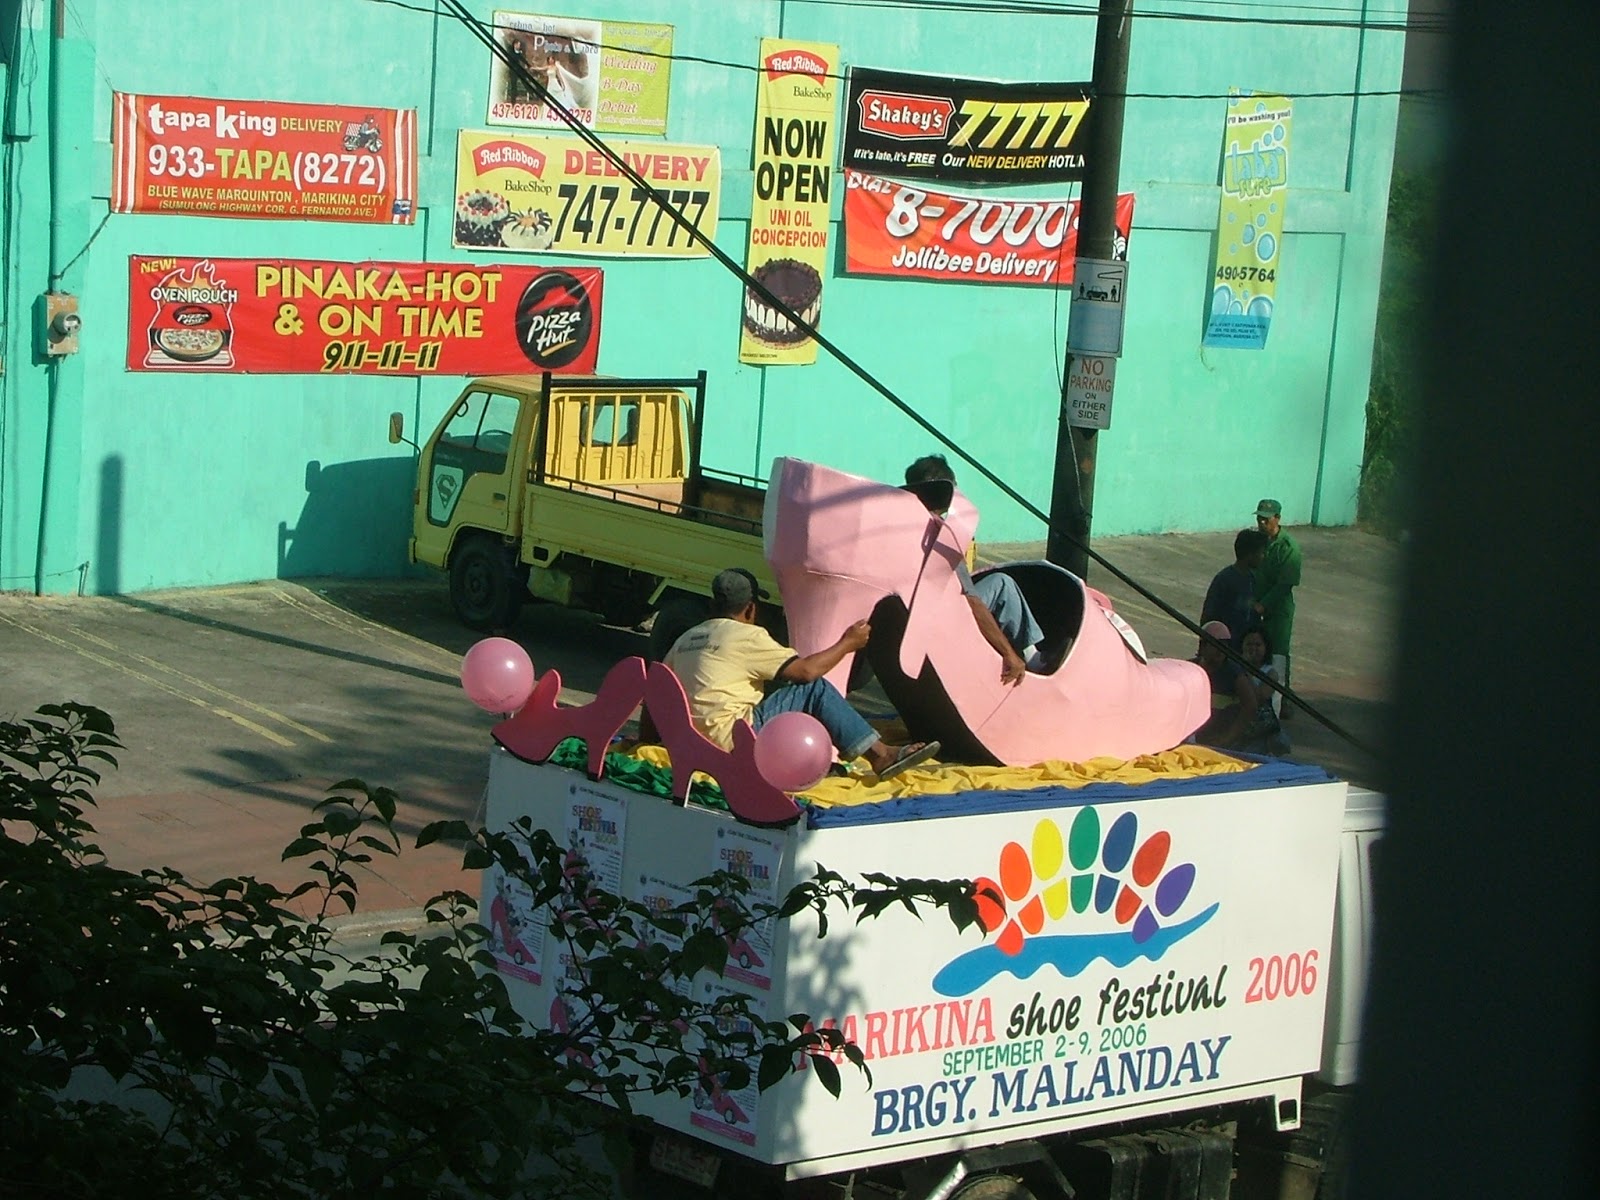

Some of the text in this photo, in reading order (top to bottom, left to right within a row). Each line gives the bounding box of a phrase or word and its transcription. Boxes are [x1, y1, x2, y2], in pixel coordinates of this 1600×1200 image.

[604, 56, 657, 74] Wedding
[772, 54, 825, 75] Red Ribbon
[793, 85, 832, 100] BakeShop
[492, 103, 539, 120] 437-6120
[601, 100, 636, 114] Debut
[868, 99, 943, 131] Shakey's
[1249, 112, 1276, 122] washing
[149, 102, 343, 139] tapa king DELIVERY
[947, 99, 1090, 149] 77777
[763, 116, 827, 159] NOW
[480, 147, 540, 169] Red Ribbon
[564, 149, 711, 182] DELIVERY
[861, 148, 873, 160] it's
[875, 149, 893, 163] late,
[893, 151, 907, 163] it's
[907, 152, 937, 165] FREE
[942, 152, 966, 168] Our
[966, 154, 996, 169] NEW
[996, 155, 1049, 169] DELIVERY
[148, 144, 386, 193] 933-TAPA(8272)
[505, 180, 552, 195] BakeShop
[756, 161, 830, 204] OPEN
[847, 172, 892, 194] DIAL
[148, 184, 178, 198] BLUE
[180, 186, 214, 200] WAVE
[216, 188, 292, 203] MARQUINTON
[301, 192, 356, 206] MARIKINA
[359, 194, 386, 207] CITY
[158, 200, 377, 218] (SUMULONG HIGHWAY COR. G. FERNANDO AVE.)
[553, 184, 710, 248] 747-7777
[769, 208, 812, 227] UNI OIL
[752, 228, 827, 248] CONCEPCION
[140, 258, 177, 274] NEW!
[891, 244, 1057, 283] Jollibee Delivery
[256, 265, 503, 304] PINAKA-HOT
[1216, 266, 1275, 283] 490-5764
[191, 288, 238, 303] POUCH
[274, 305, 484, 339] & ON TIME
[527, 310, 581, 343] Pizza
[536, 325, 575, 352] Hut
[320, 339, 443, 372] 911-11-11
[1080, 360, 1104, 376] NO
[1070, 375, 1112, 393] PARKING
[1072, 400, 1106, 411] EITHER
[1085, 392, 1097, 400] ON
[1078, 410, 1099, 421] SIDE
[720, 848, 753, 863] SHOE
[1007, 993, 1081, 1039] shoe
[1097, 964, 1228, 1026] festival
[1244, 949, 1319, 1004] 2006
[942, 1041, 1044, 1077] SEPTEMBER
[1100, 1023, 1147, 1053] 2006
[872, 1035, 1232, 1137] BRGY. MALANDAY
